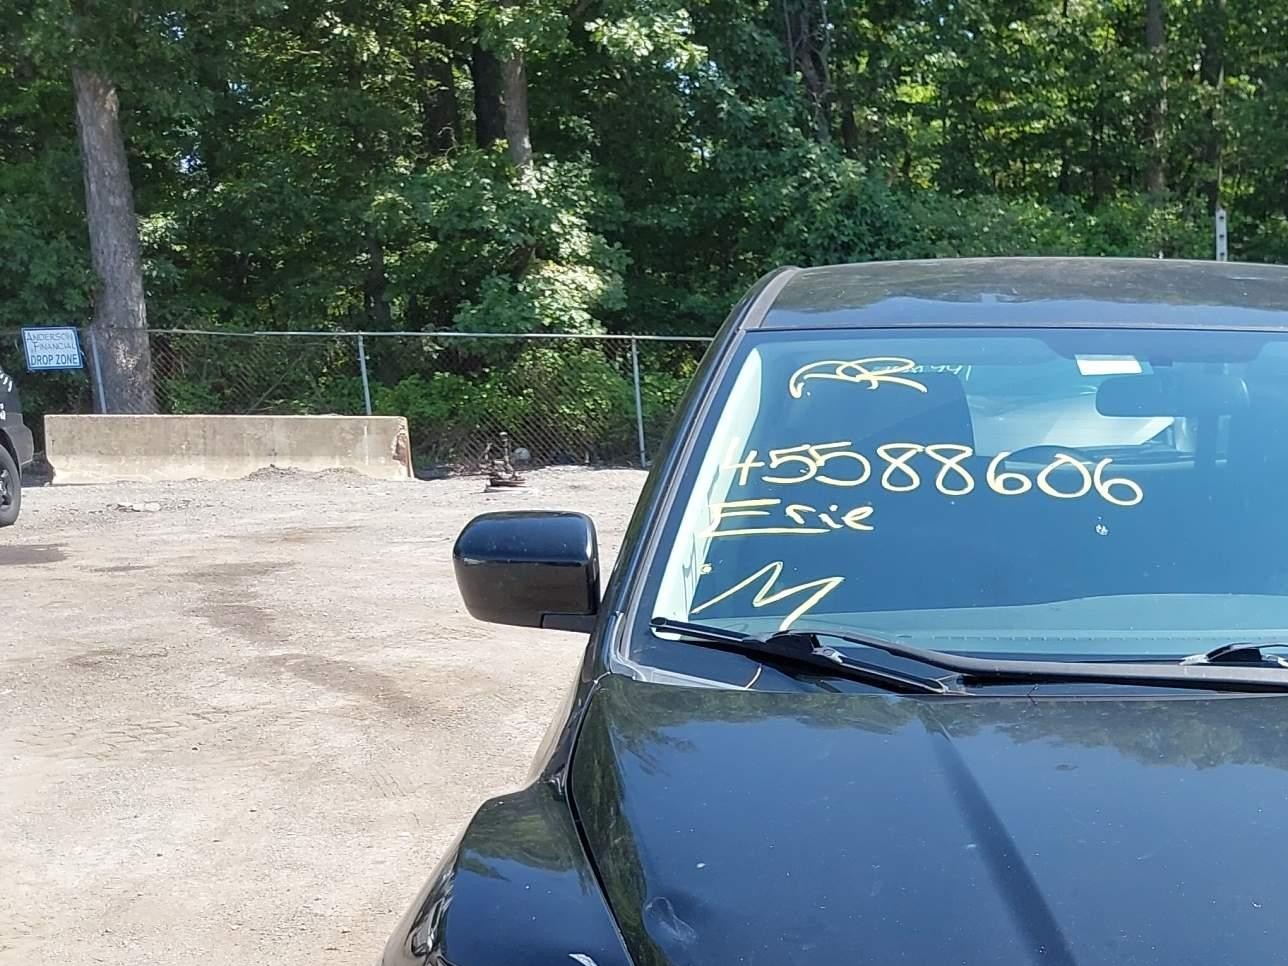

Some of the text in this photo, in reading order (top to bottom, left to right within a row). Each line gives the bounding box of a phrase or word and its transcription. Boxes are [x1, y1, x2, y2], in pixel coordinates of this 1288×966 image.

[32, 354, 78, 365] DROP ZONE
[700, 497, 874, 537] Erie
